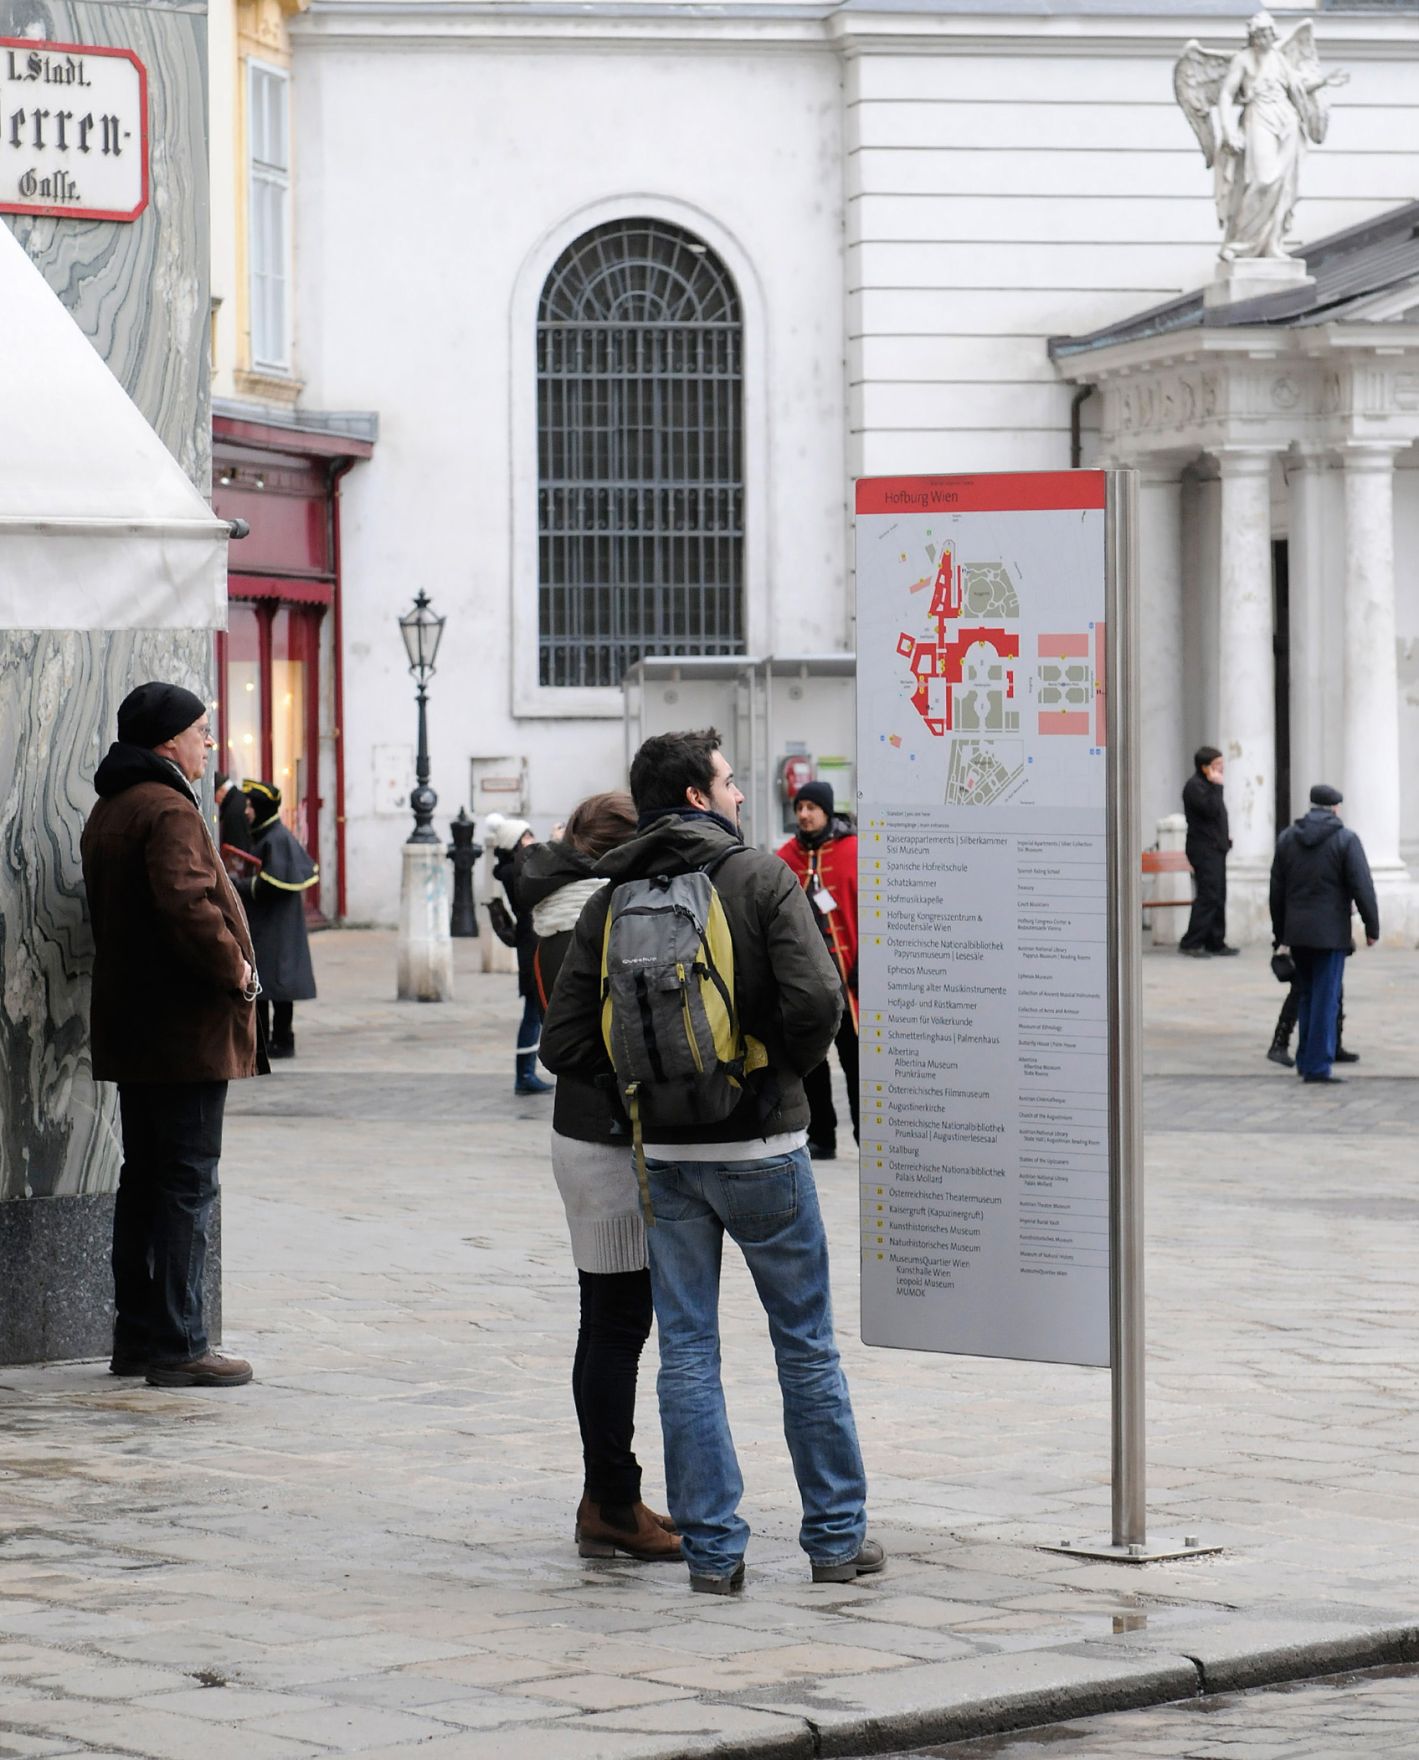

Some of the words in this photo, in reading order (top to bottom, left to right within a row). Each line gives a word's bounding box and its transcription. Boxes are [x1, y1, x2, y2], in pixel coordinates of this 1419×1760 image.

[0, 108, 131, 157] erren-
[885, 490, 928, 506] Hofburg
[931, 490, 958, 503] Wien
[887, 835, 954, 844] Kaiserappartements
[960, 836, 1008, 845] Silberkammer
[900, 846, 929, 854] Museum
[887, 862, 920, 871] Spanische
[922, 863, 968, 872] Hofreitschule
[887, 878, 936, 887] Schatzkammer
[887, 895, 944, 905] Hofmusikkapelle
[887, 911, 915, 922] Hofburg
[917, 912, 976, 922] Kongresszentrum
[887, 923, 932, 931] Redoutensäle
[934, 924, 951, 932] Wien
[887, 936, 939, 948] Österreichische
[941, 940, 1004, 950] Nationalbibliothek
[894, 950, 950, 960] Papyrusmuseum
[956, 952, 984, 960] Lesesäle
[887, 965, 915, 976] Ephesos
[917, 966, 947, 975] Museum
[888, 982, 924, 994] Sammlung
[926, 984, 941, 992] alter
[944, 984, 1007, 994] Musikinstrumente
[888, 998, 916, 1009] Hofjagd-
[919, 1000, 932, 1008] und
[934, 1000, 977, 1010] Rüstkammer
[888, 1015, 918, 1023] Museum
[919, 1015, 929, 1024] für
[931, 1016, 973, 1026] Völkerkunde
[888, 1030, 952, 1043] Schmetterlinghaus
[957, 1034, 999, 1044] Palmenhaus
[888, 1047, 919, 1056] Albertina
[895, 1058, 926, 1068] Albertina
[928, 1061, 958, 1069] Museum
[895, 1069, 936, 1079] Prunkräume
[888, 1084, 943, 1096] Österreichisches
[945, 1088, 990, 1099] Filmmuseum
[888, 1102, 946, 1113] Augustinerkirche
[888, 1117, 940, 1128] Österreichische
[942, 1121, 1005, 1132] Nationalbibliothek
[896, 1129, 928, 1138] Prunksaal
[933, 1132, 997, 1143] Augustinerlesesaal
[889, 1145, 919, 1157] Stallburg
[889, 1160, 940, 1173] Österreichische
[942, 1165, 1005, 1177] Nationalbibliothek
[896, 1173, 915, 1182] Palais
[916, 1174, 942, 1184] Mollard
[889, 1188, 943, 1200] Österreichisches
[945, 1192, 1002, 1205] Theatermuseum
[889, 1206, 926, 1217] Kaisergruft
[928, 1208, 984, 1220] (Kapuzinergruft)
[889, 1222, 948, 1234] Kunsthistorisches
[950, 1226, 981, 1236] Museum
[890, 1238, 948, 1250] Naturhistorisches
[951, 1242, 981, 1252] Museum
[889, 1254, 951, 1266] MuseumsQuartier
[953, 1258, 970, 1268] Wien
[896, 1266, 932, 1276] Kunsthalle
[933, 1268, 951, 1277] Wien
[897, 1277, 922, 1287] Leopold
[924, 1279, 954, 1288] Museum
[896, 1288, 926, 1297] MUMOK
